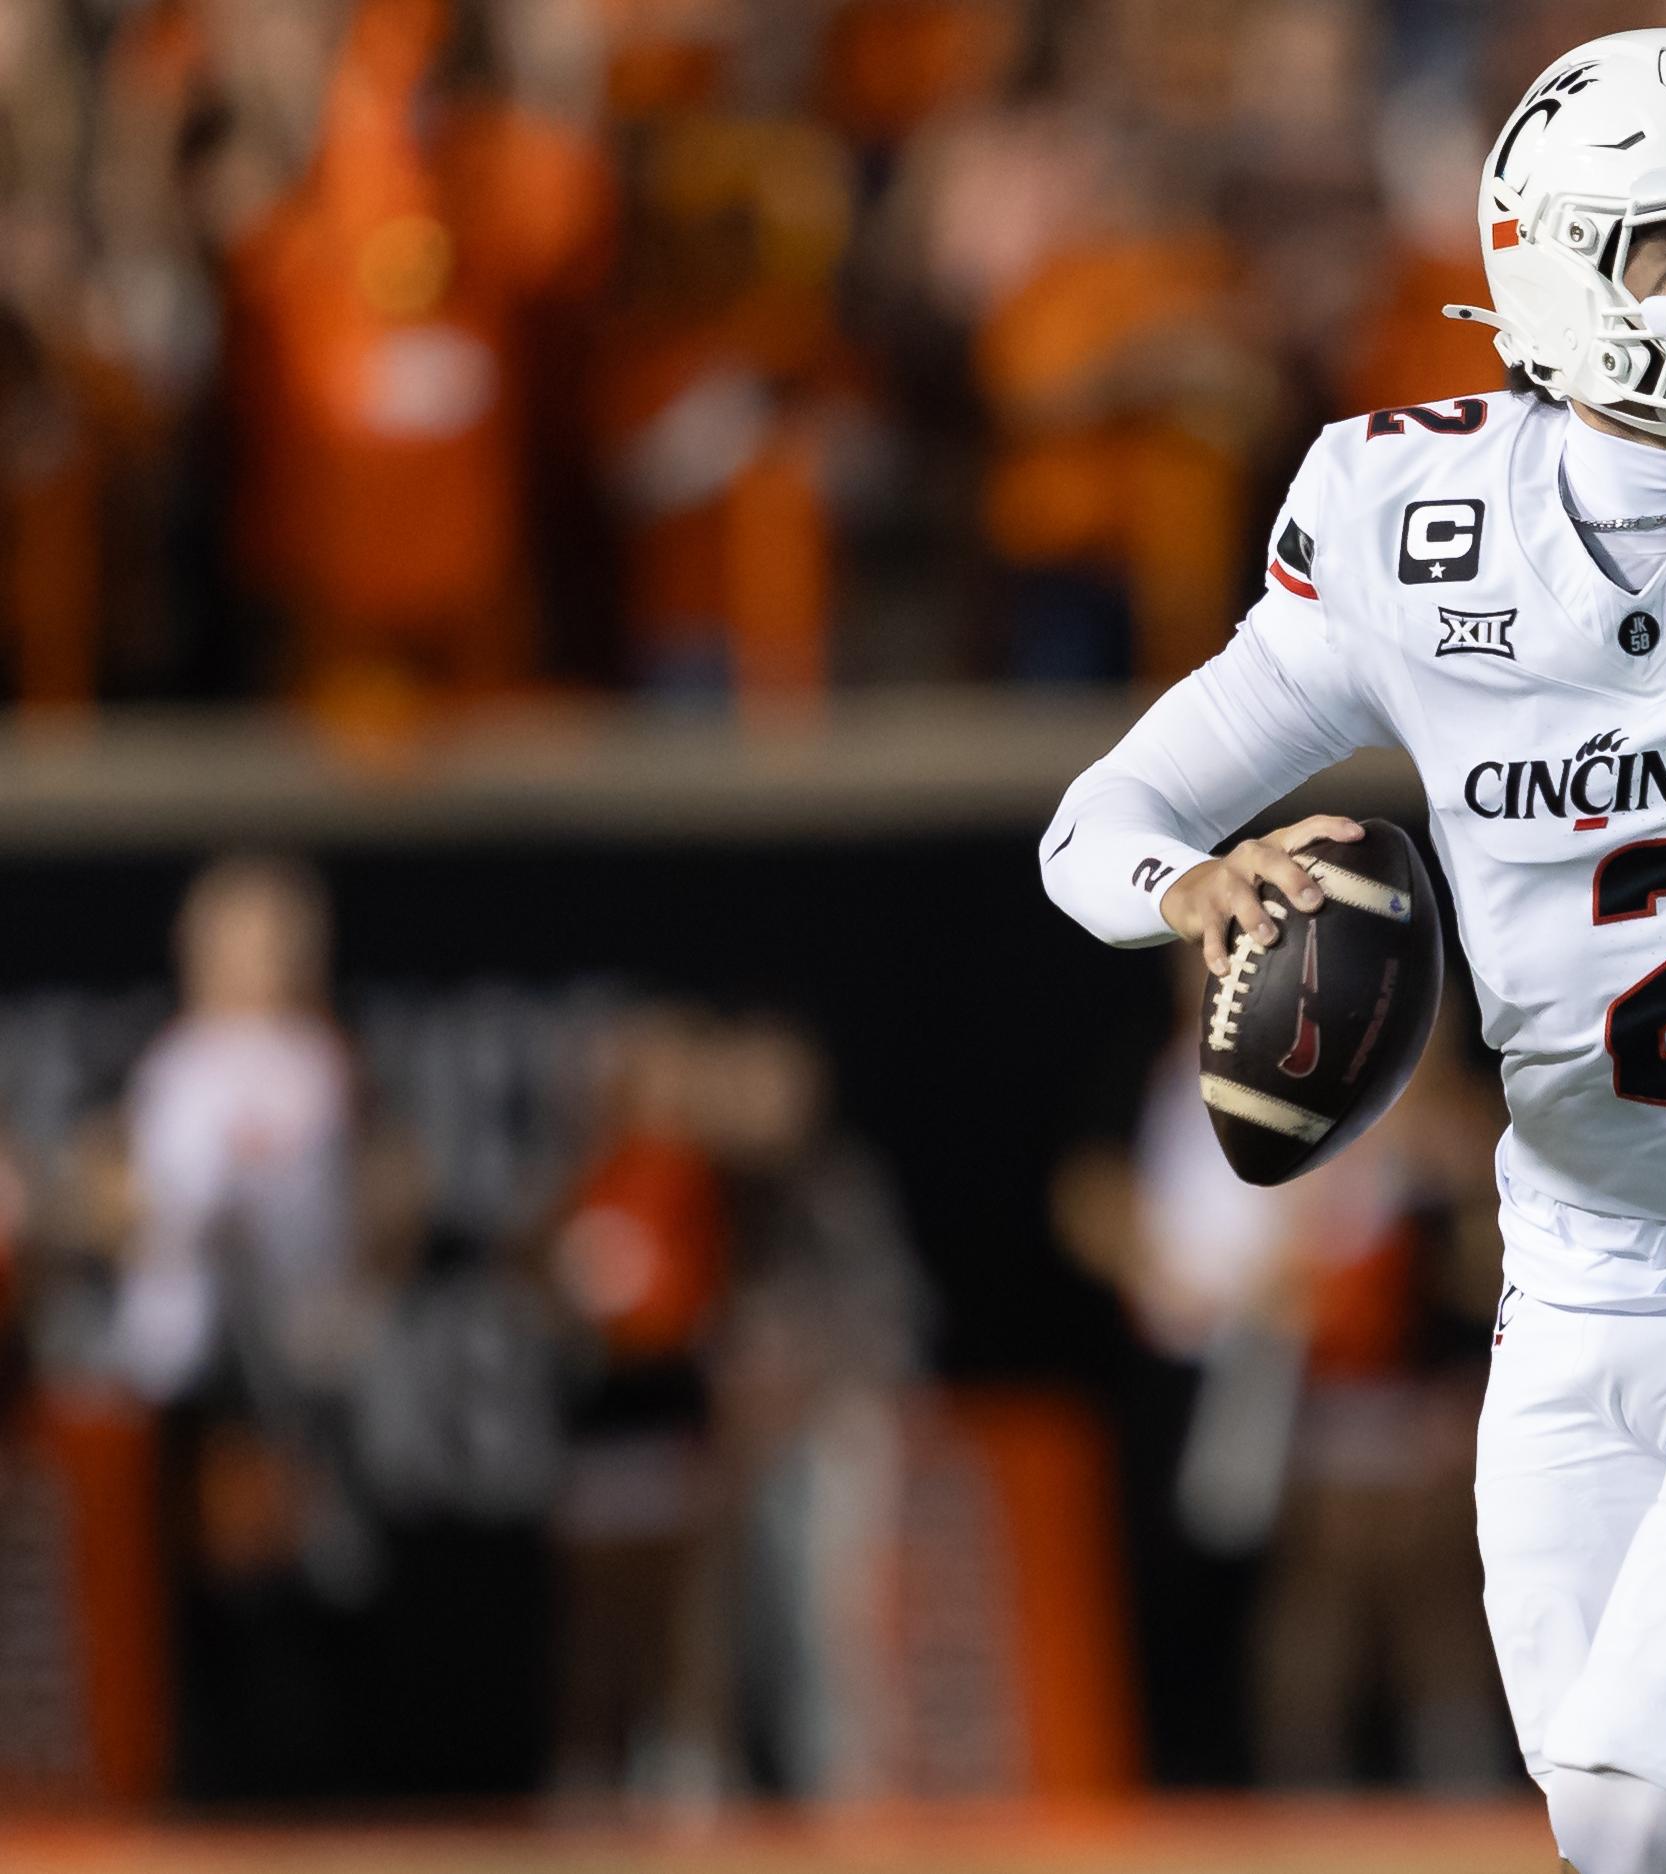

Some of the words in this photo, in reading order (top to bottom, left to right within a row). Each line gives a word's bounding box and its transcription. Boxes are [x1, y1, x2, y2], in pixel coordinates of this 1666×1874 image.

[1367, 398, 1487, 441] 2
[1407, 504, 1475, 561] C
[1630, 616, 1648, 634] JK
[1631, 633, 1650, 651] 58
[1132, 857, 1175, 893] 2
